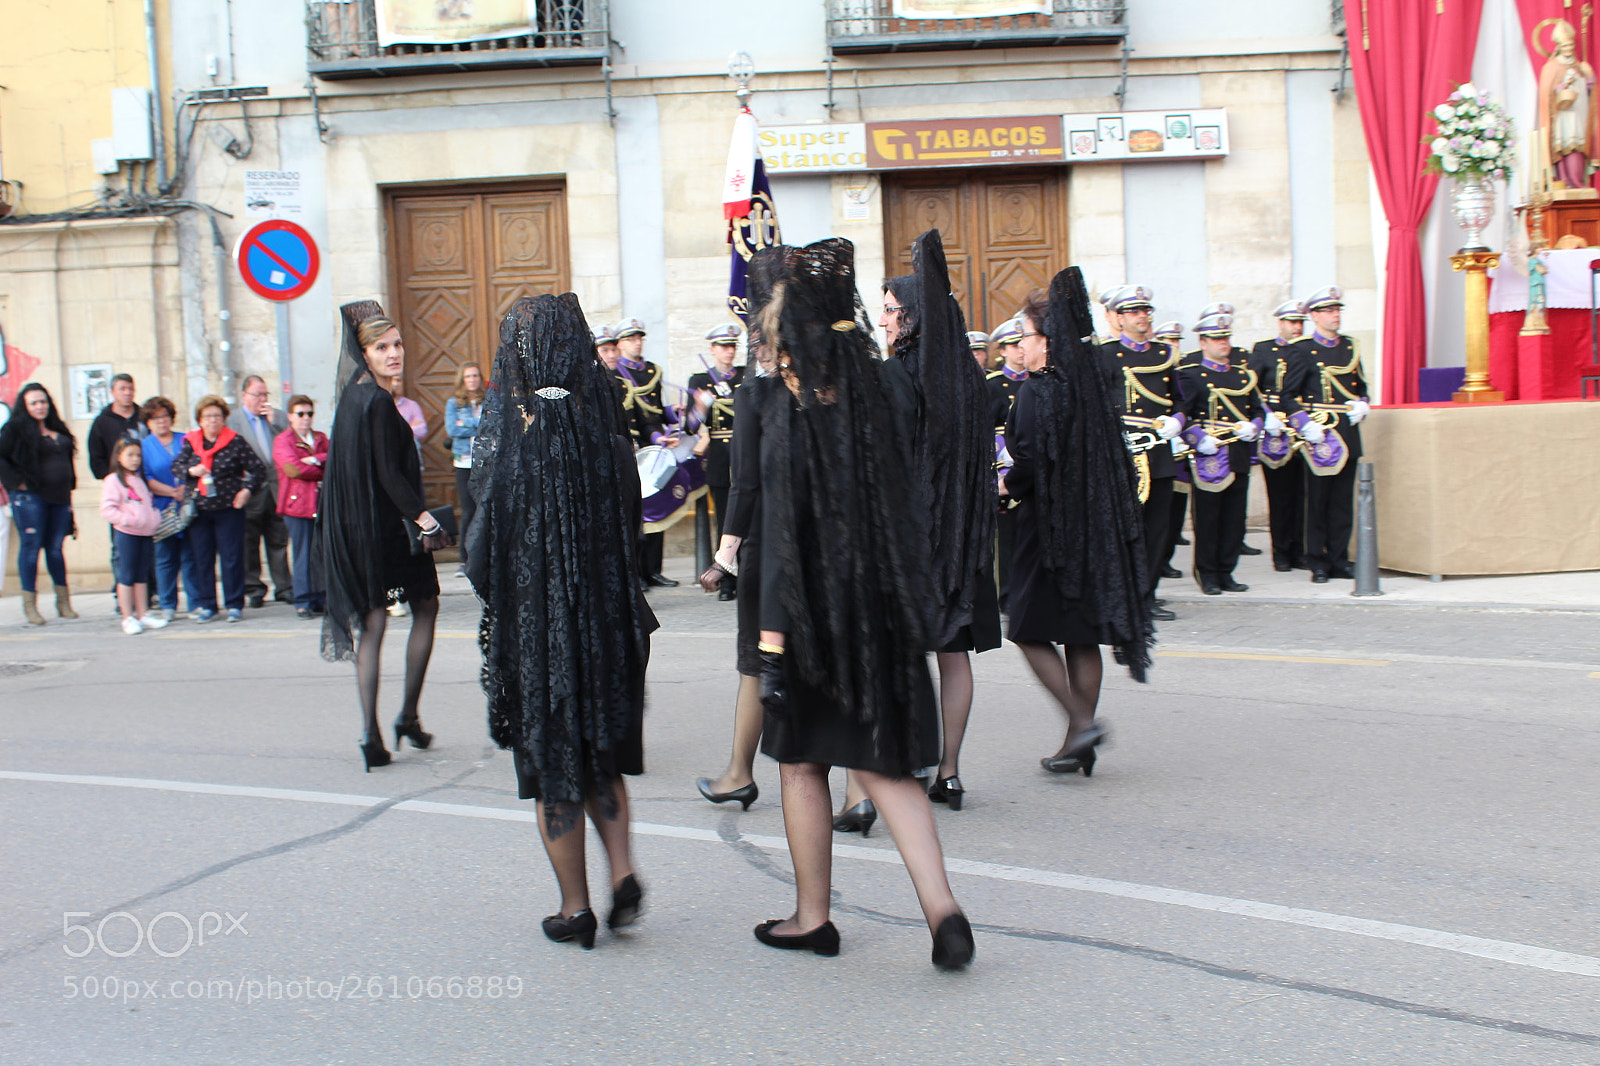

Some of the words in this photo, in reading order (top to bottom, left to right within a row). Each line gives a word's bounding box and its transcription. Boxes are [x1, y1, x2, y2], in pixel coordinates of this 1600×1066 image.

[759, 131, 850, 150] Super
[915, 126, 1048, 149] TABACOS
[764, 152, 867, 168] stanco
[246, 170, 300, 180] RESERVADO
